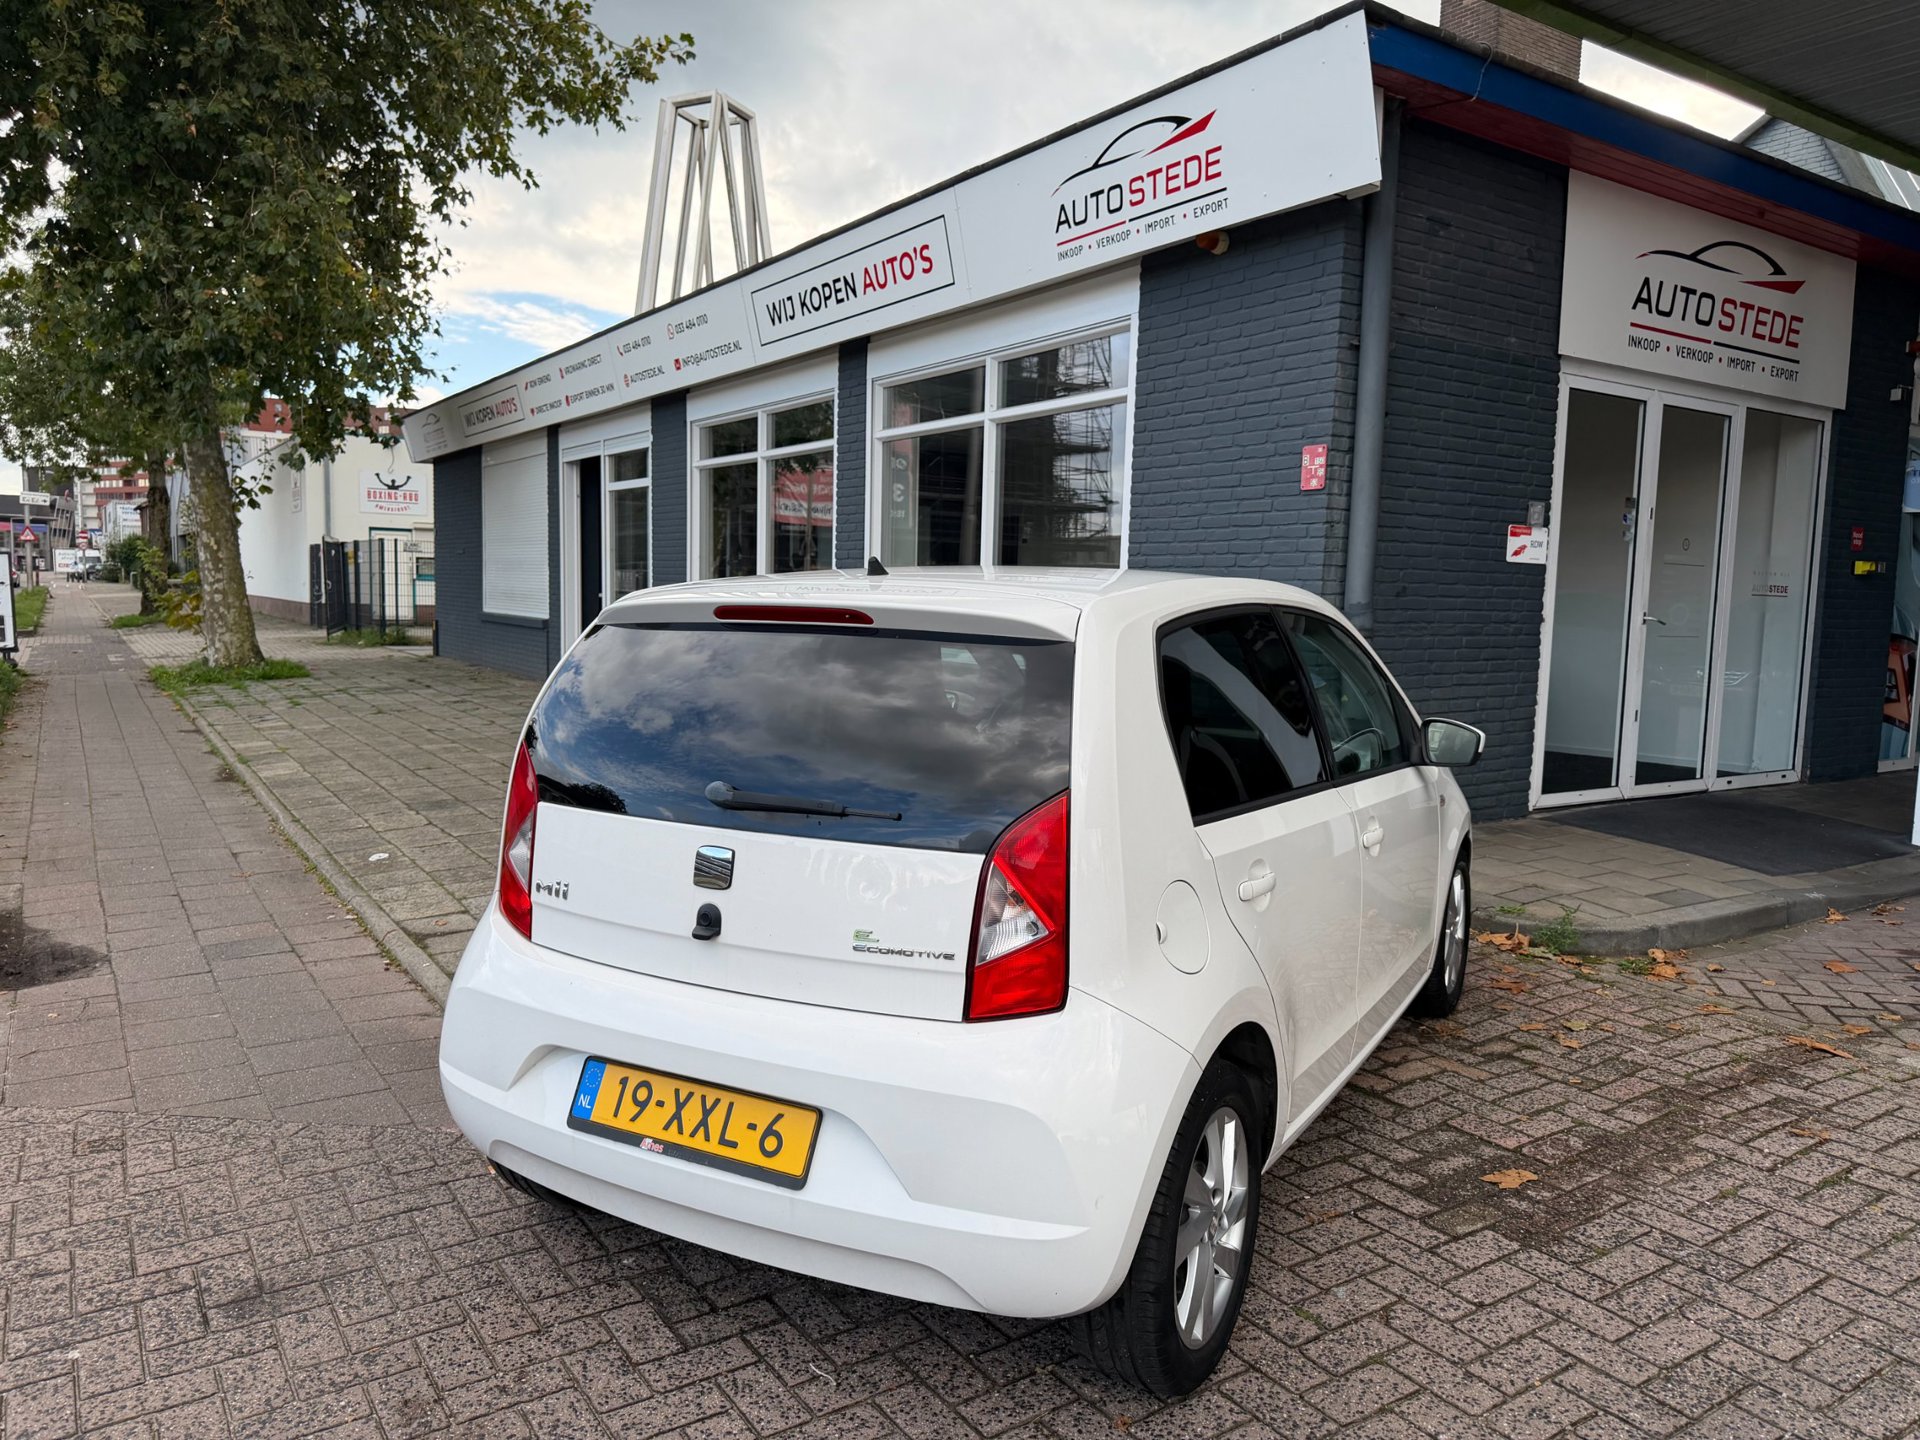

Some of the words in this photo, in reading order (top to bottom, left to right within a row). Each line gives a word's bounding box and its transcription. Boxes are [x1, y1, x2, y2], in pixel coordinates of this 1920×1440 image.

[1057, 244, 1084, 262] INKOOP
[1095, 229, 1132, 249] VERKOOP
[1144, 214, 1176, 234] IMPORT
[1193, 197, 1229, 219] EXPORT
[765, 295, 796, 327] WIJ
[798, 272, 858, 317] KOPEN
[863, 244, 934, 295] AUTO'S
[681, 340, 743, 367] INFO@AUTOSTEDE.NL
[1627, 334, 1661, 353] INKOOP
[1675, 344, 1714, 364] VERKOOP
[1726, 355, 1756, 373] IMPORT
[1769, 365, 1800, 382] EXPORT
[630, 365, 665, 384] AUTOSTEDE.NL
[475, 404, 496, 423] KOPEN
[577, 1093, 592, 1109] NL
[612, 1076, 785, 1158] 19-XXL-6
